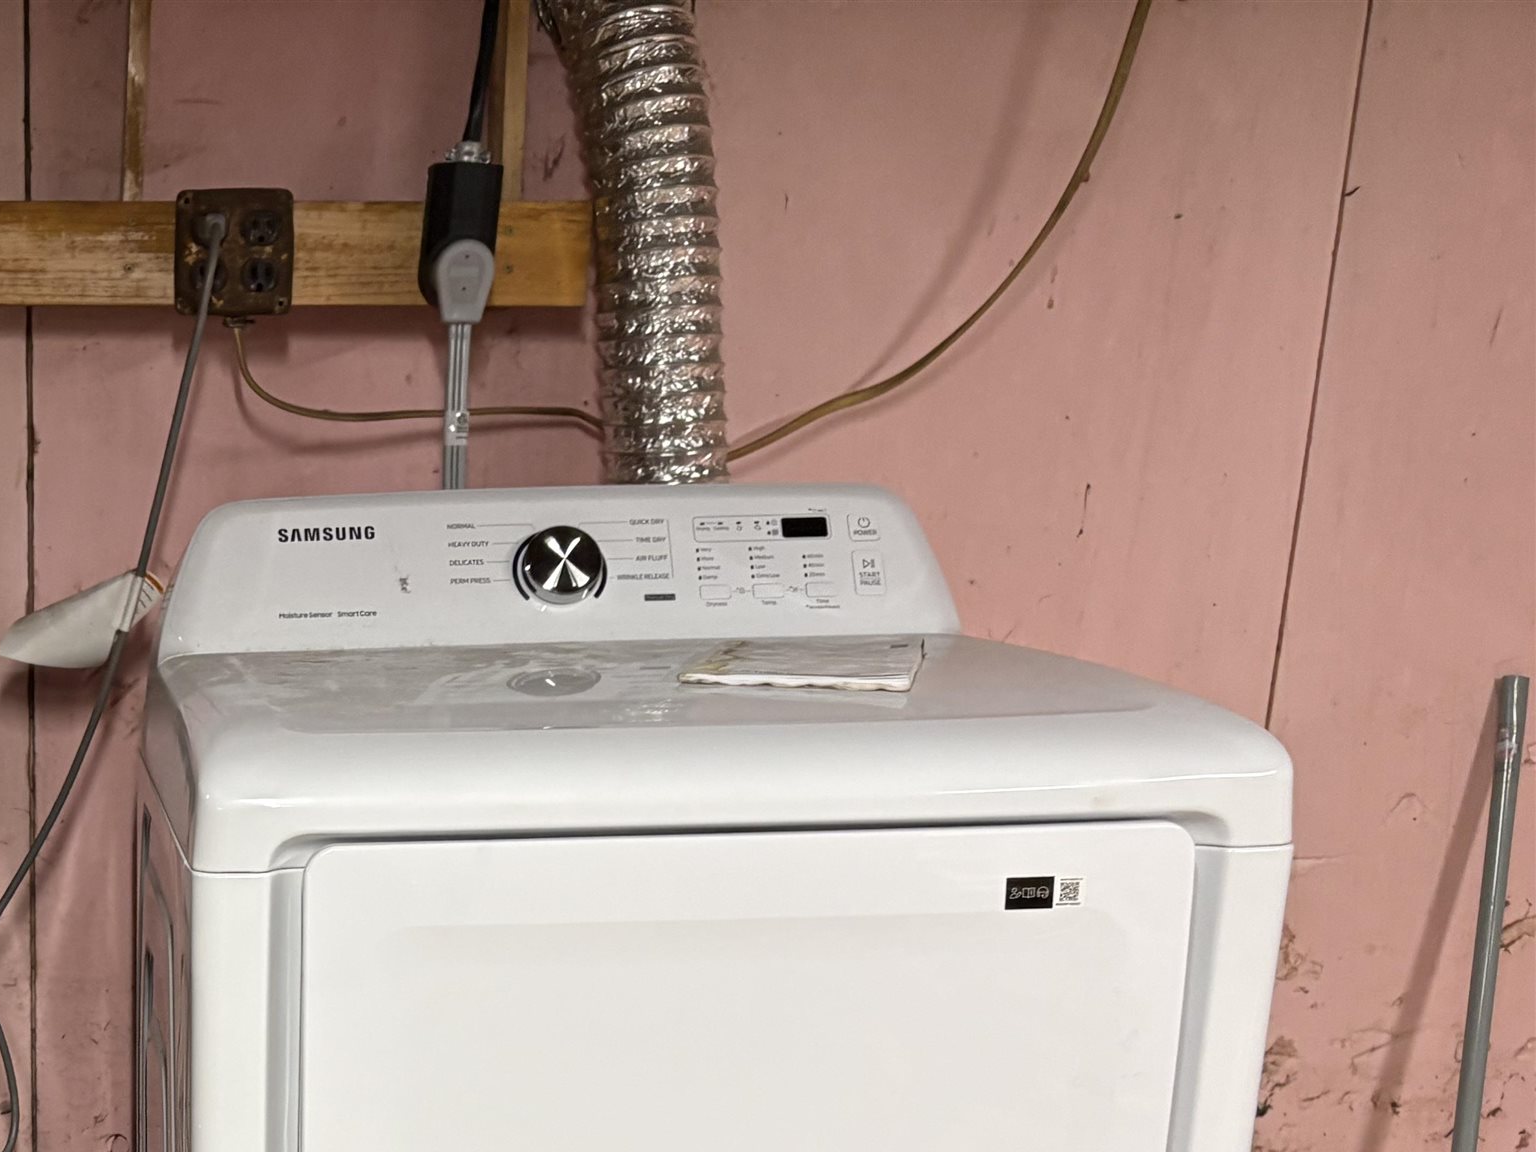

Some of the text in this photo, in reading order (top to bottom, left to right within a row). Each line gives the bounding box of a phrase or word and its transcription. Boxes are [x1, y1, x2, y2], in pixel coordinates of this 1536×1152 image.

[277, 525, 376, 543] SAMSUNG
[449, 559, 485, 567] DELICATES
[278, 611, 308, 619] Moisture
[337, 610, 359, 618] Smart
